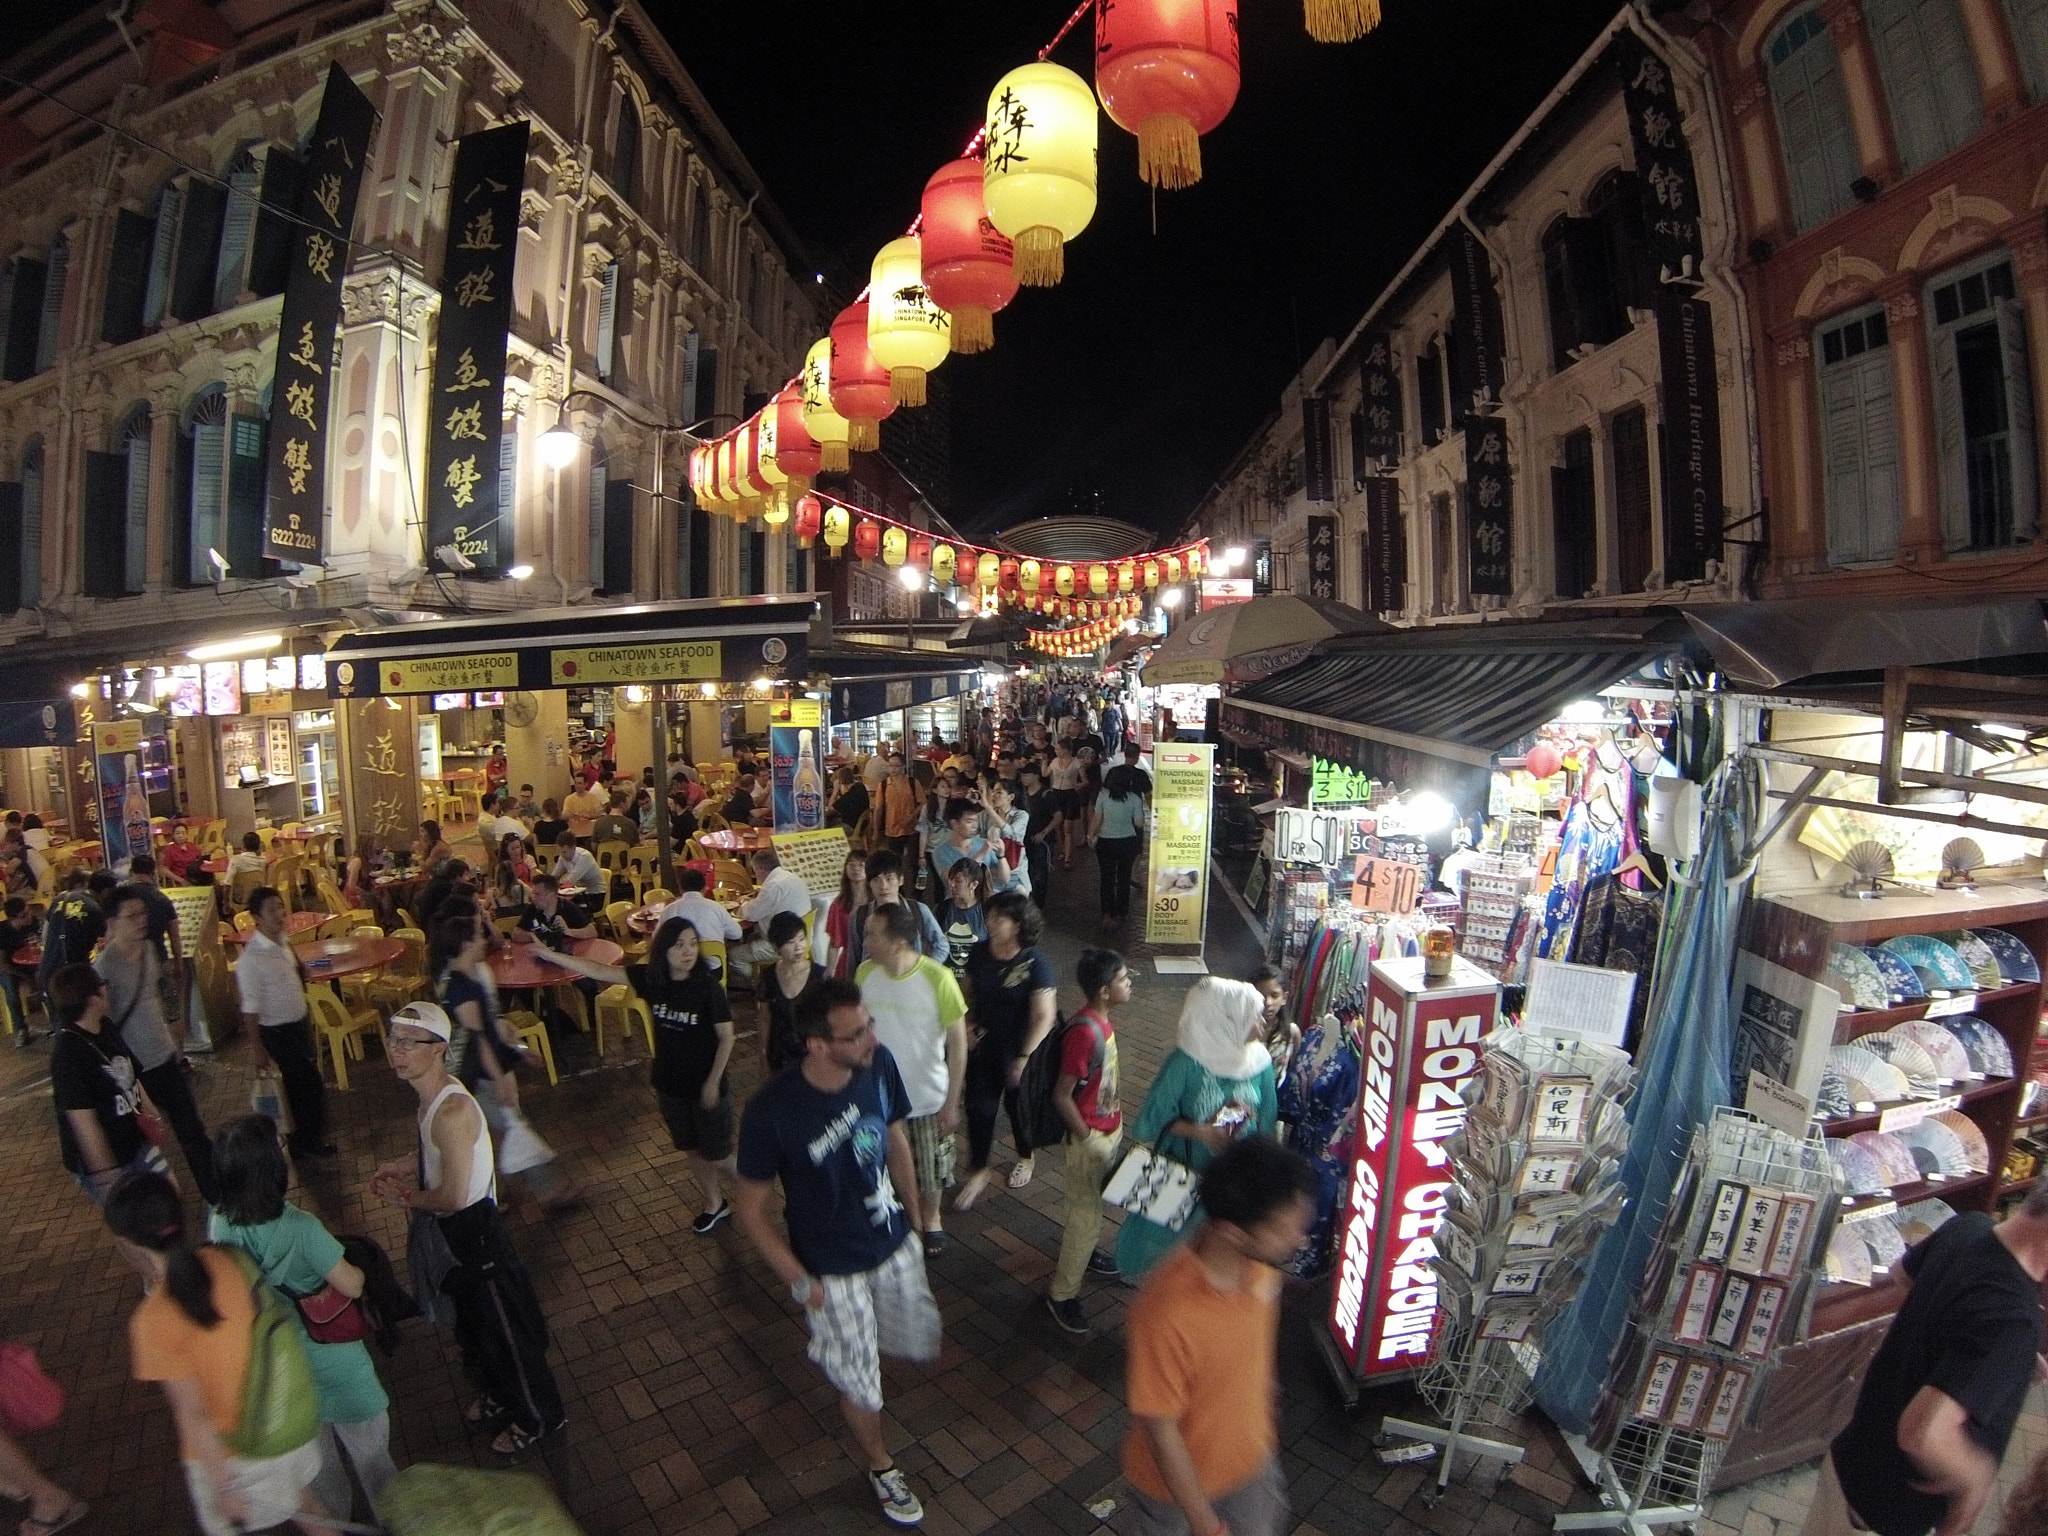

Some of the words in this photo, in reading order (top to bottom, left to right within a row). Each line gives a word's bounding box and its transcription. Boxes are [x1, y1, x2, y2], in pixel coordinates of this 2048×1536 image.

[1464, 232, 1477, 290] Chinatown
[1472, 294, 1484, 343] Heritage
[894, 308, 926, 316] CHINATOWN
[1681, 302, 1698, 397] Chinatown
[1689, 404, 1704, 482] Heritage
[271, 527, 294, 547] 6222
[295, 531, 316, 550] 2224
[1694, 489, 1706, 551] Centre
[462, 539, 488, 556] 2224
[410, 659, 466, 673] CHINATOWN
[467, 657, 512, 669] SEAFOOD
[588, 648, 656, 662] CHINATOWN
[659, 645, 714, 658] SEAFOOD
[762, 665, 786, 677] Tiger
[1317, 781, 1330, 798] 3
[1345, 779, 1370, 800] $10
[1277, 811, 1290, 859] 10
[1291, 842, 1306, 857] FOR
[1381, 816, 1390, 830] 6
[1357, 861, 1376, 907] 4
[1382, 865, 1416, 915] $10
[1363, 996, 1398, 1152] MONEY
[1412, 1015, 1481, 1167] MONEY
[1753, 1080, 1770, 1095] NAME
[1772, 1090, 1806, 1112] BOOKMARK
[1335, 1158, 1379, 1349] CHANGER
[1378, 1182, 1453, 1360] CHANGER
